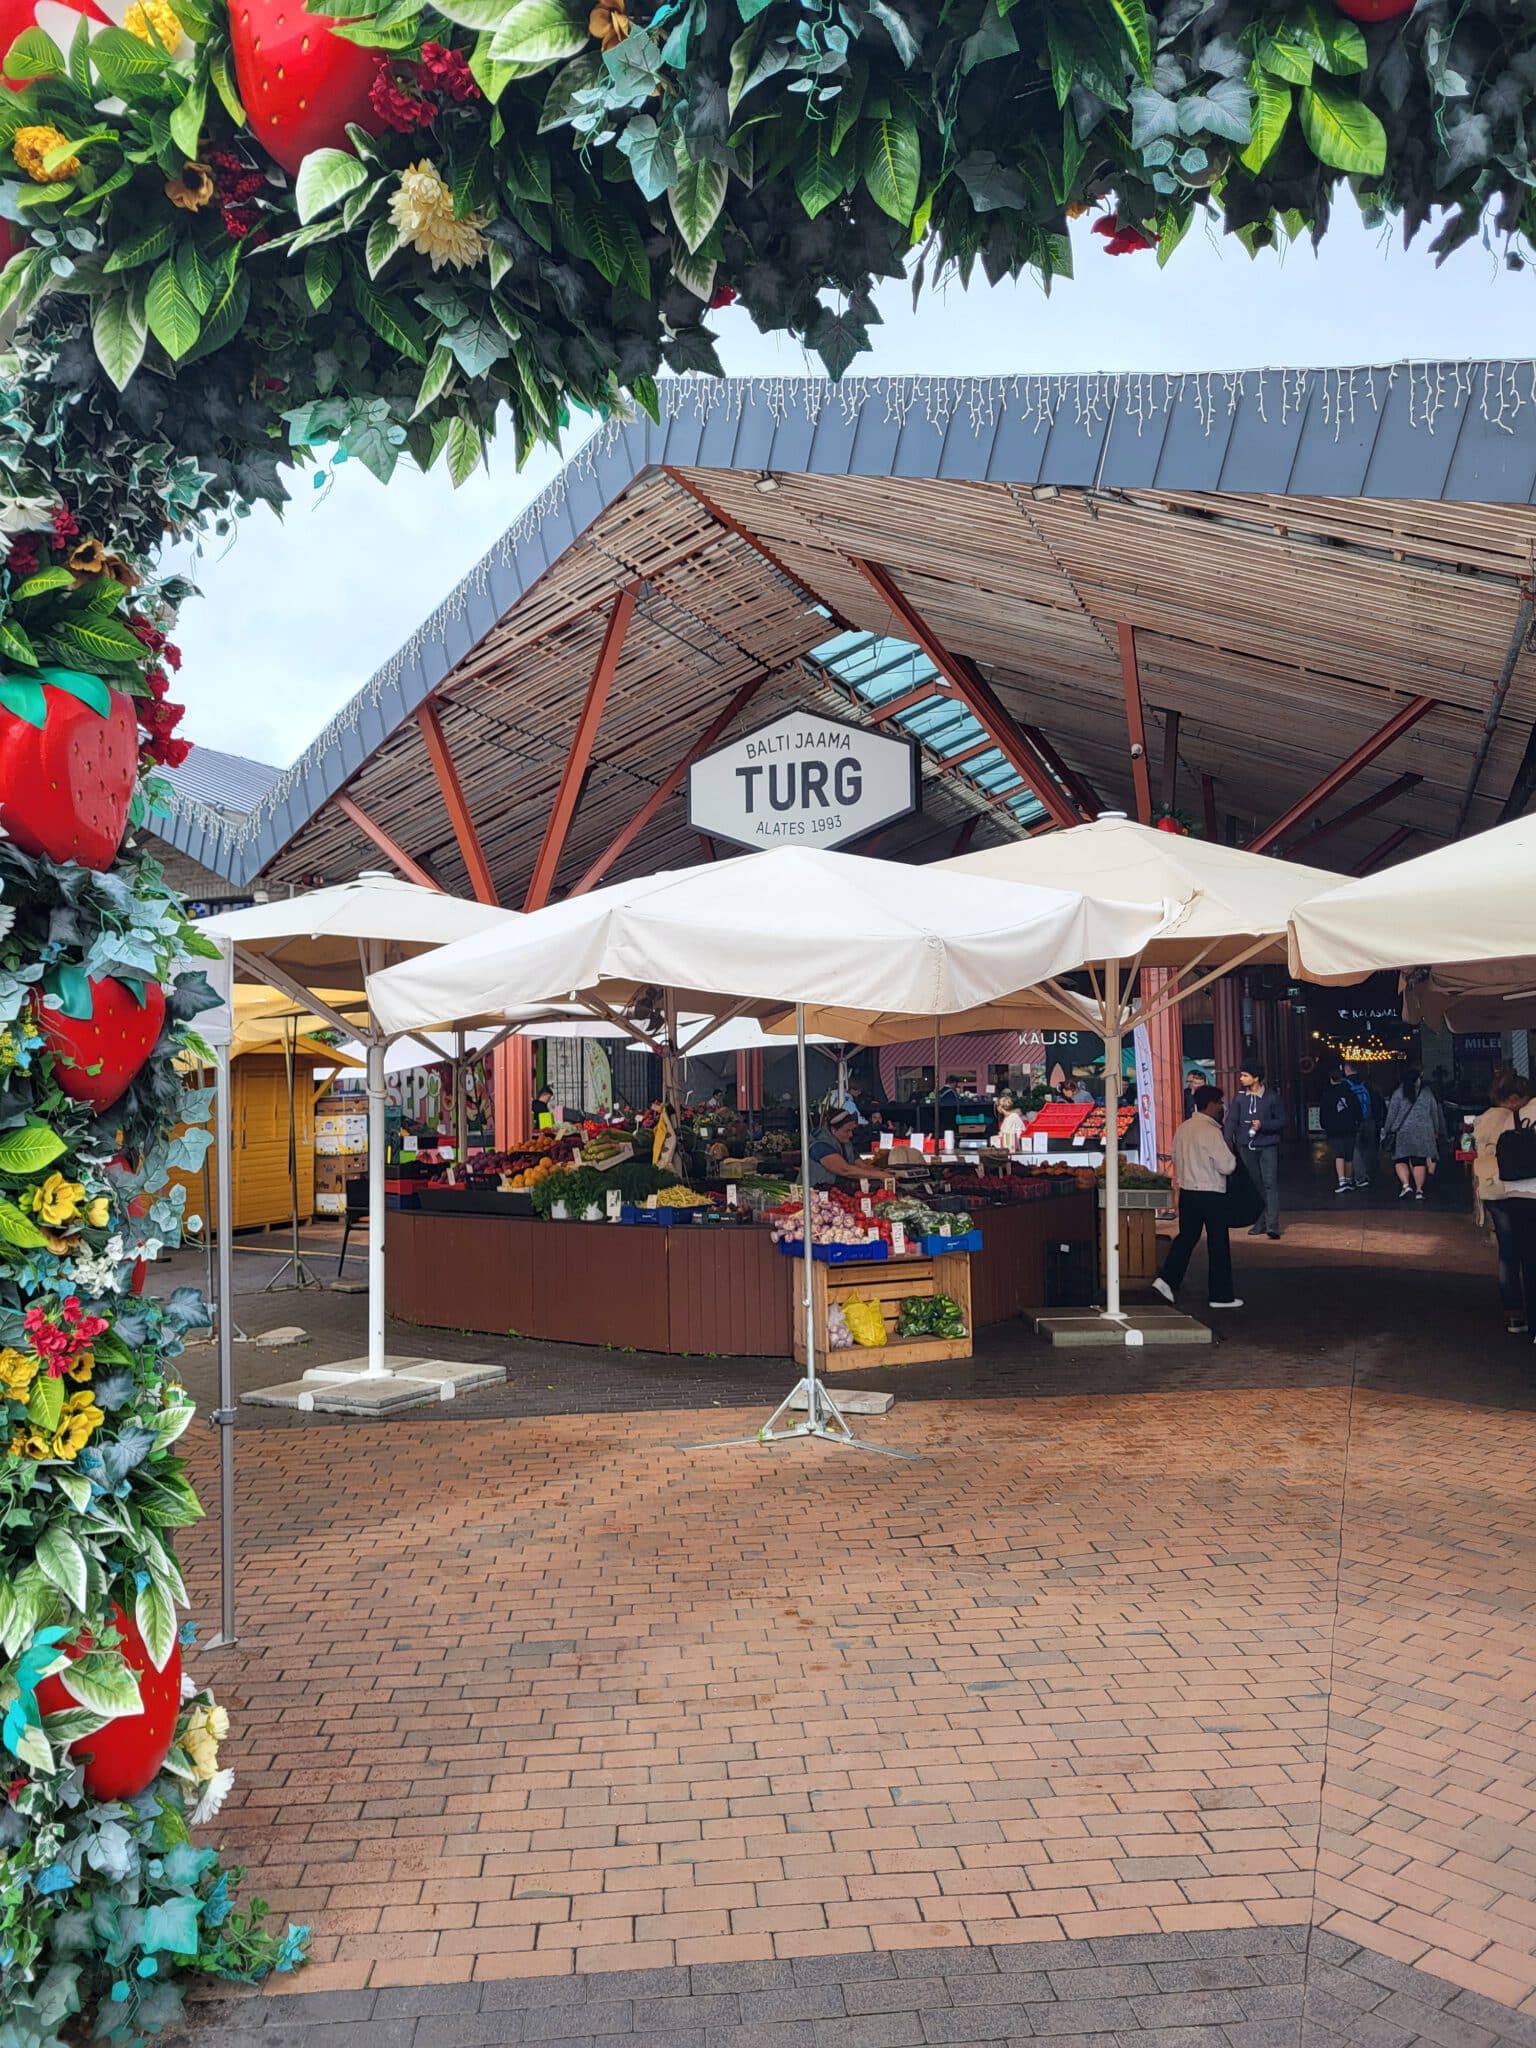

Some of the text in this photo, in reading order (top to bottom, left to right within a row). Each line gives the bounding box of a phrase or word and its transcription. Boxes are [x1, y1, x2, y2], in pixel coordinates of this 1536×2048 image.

[746, 731, 851, 759] BALTI JAAMA
[735, 757, 862, 814] TURG
[756, 814, 842, 836] ALATES 1993
[1018, 1031, 1079, 1046] KAUSS
